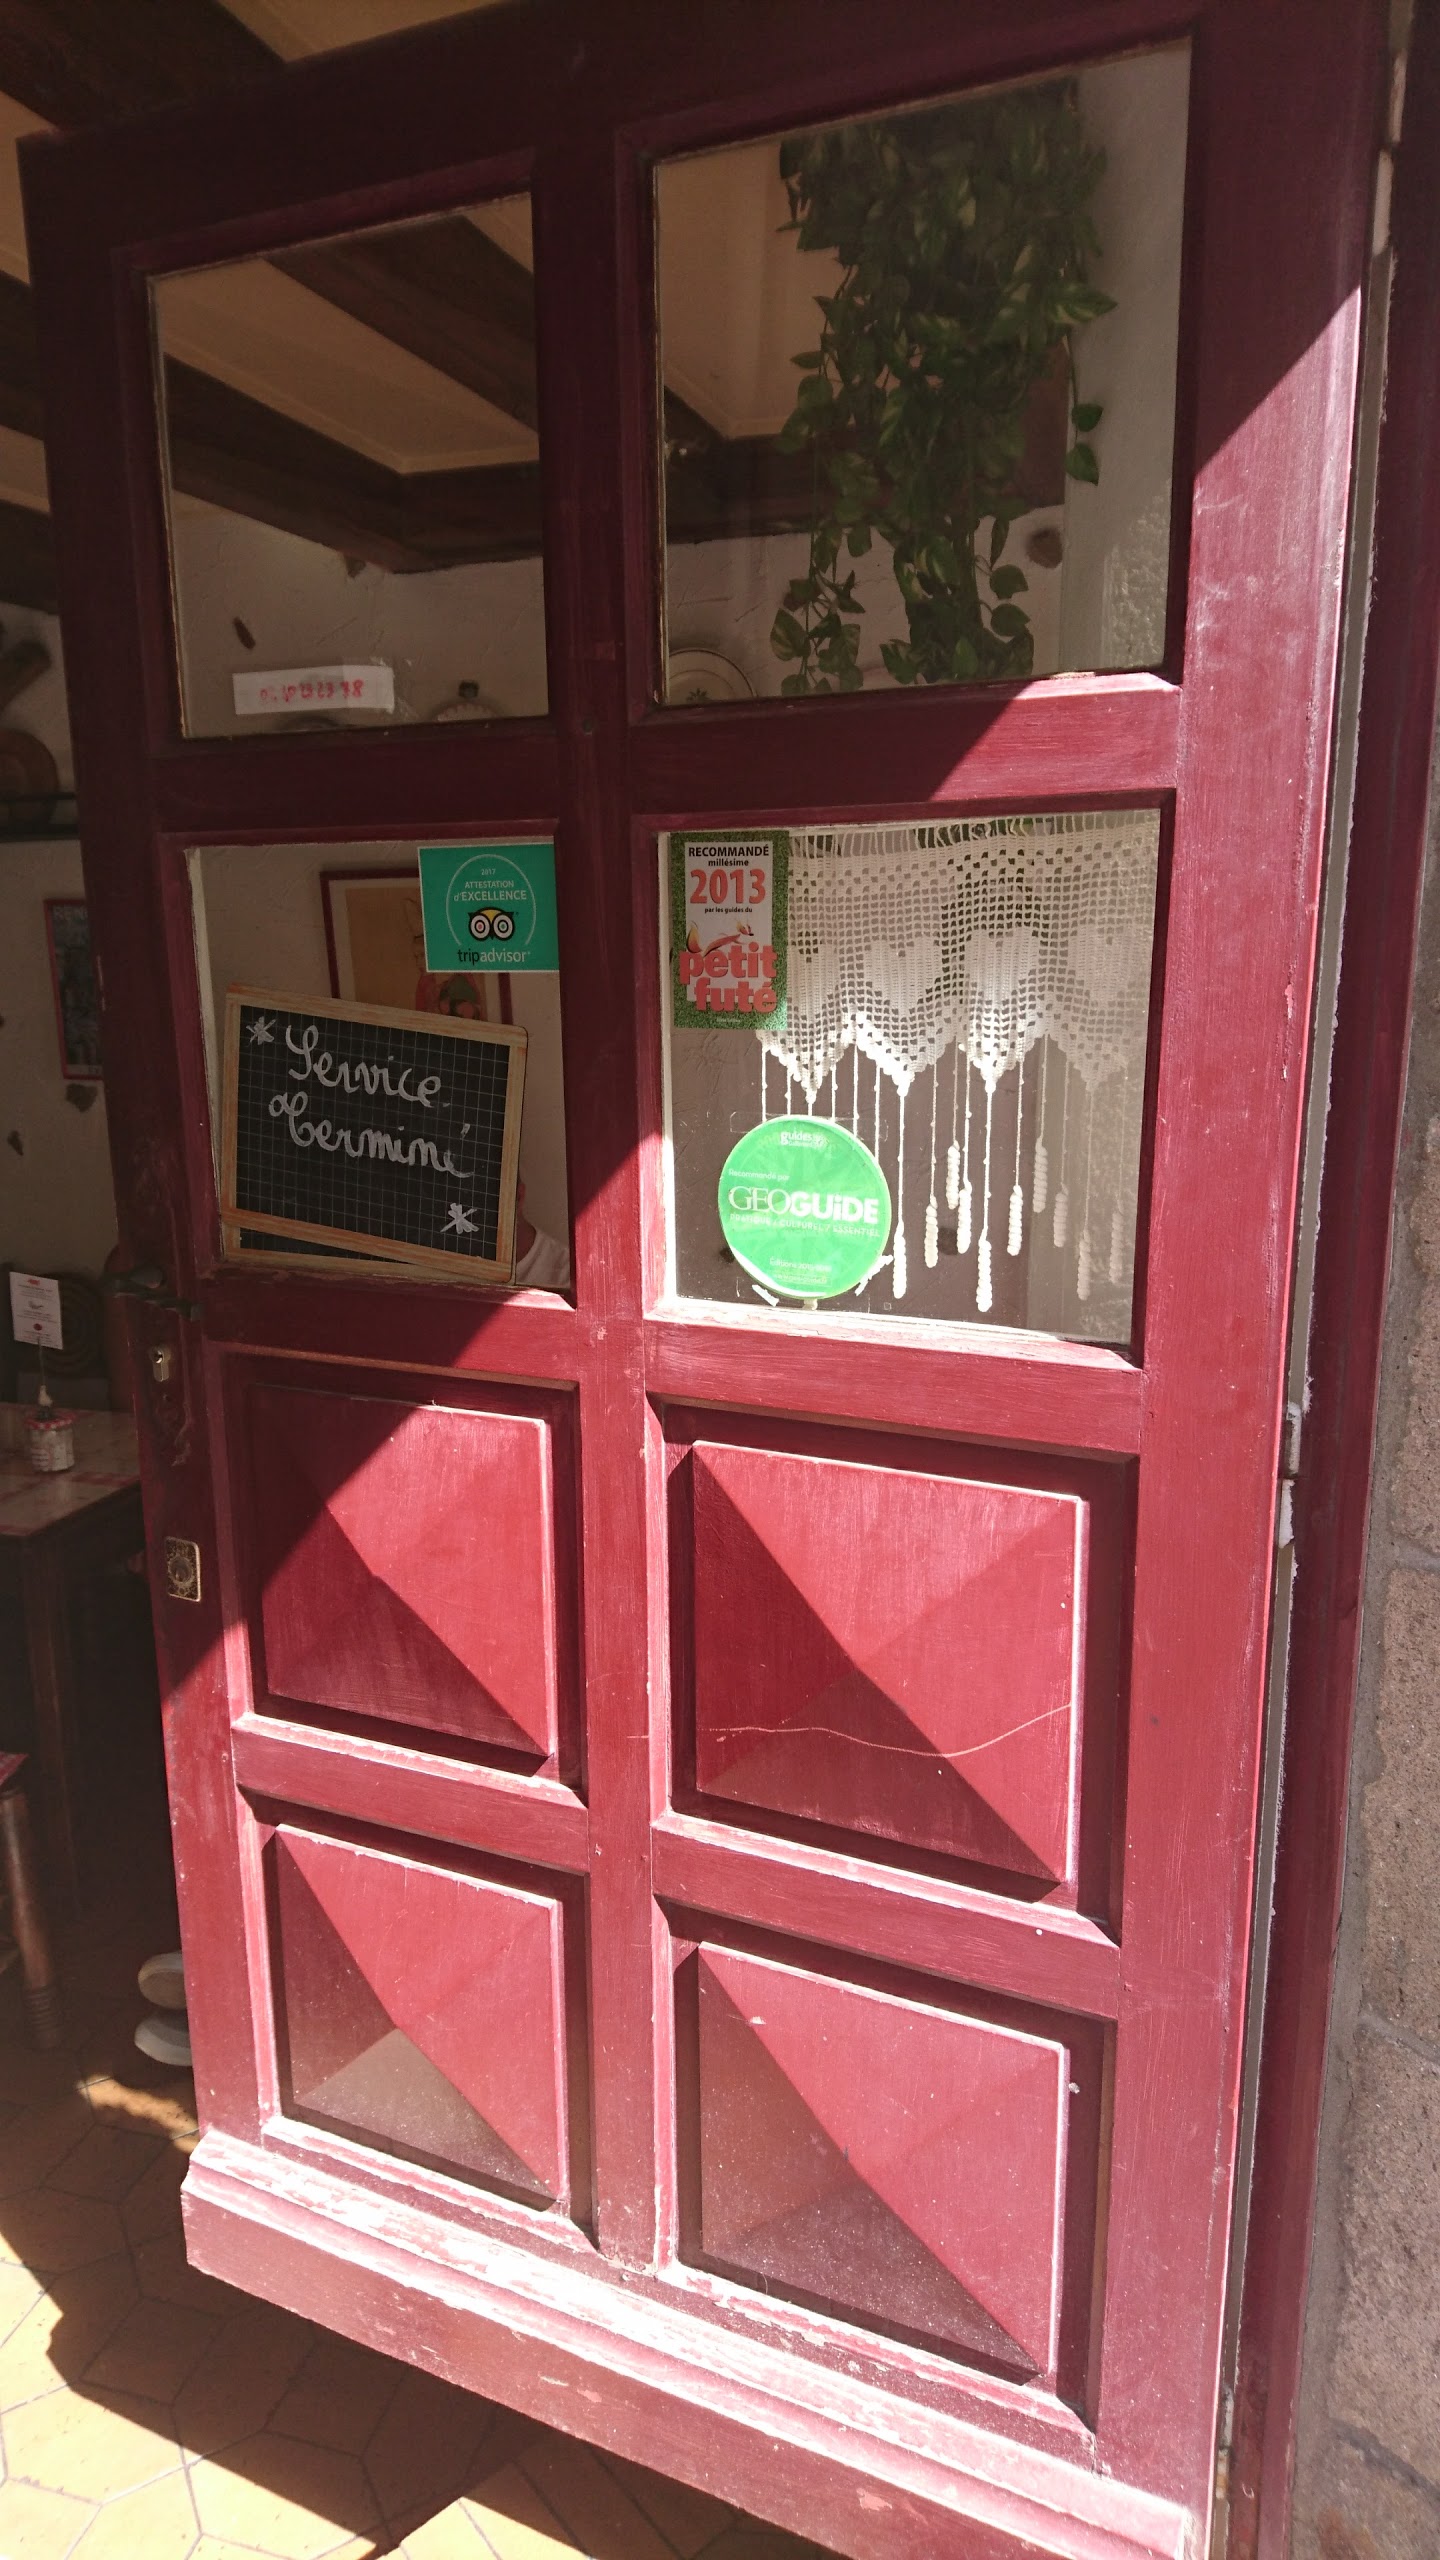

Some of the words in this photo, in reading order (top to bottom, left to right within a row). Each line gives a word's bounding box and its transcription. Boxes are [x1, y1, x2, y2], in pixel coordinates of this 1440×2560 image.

[688, 844, 769, 857] RECOMMANDÉ
[708, 858, 749, 867] millésime
[481, 868, 496, 876] 2017
[464, 880, 514, 889] ATTESTATION
[689, 868, 766, 905] 2013
[454, 890, 527, 901] d'EXCELLENCE
[724, 906, 744, 914] guides
[457, 948, 526, 966] tripadvisor
[678, 941, 778, 985] petit
[694, 976, 778, 1014] futé
[285, 1024, 442, 1108] Service
[728, 1168, 777, 1181] Recommandé
[777, 1173, 790, 1182] par
[730, 1213, 771, 1226] PRATIQUE
[779, 1218, 824, 1232] CULTUREL
[832, 1224, 880, 1237] ESSENTIEL
